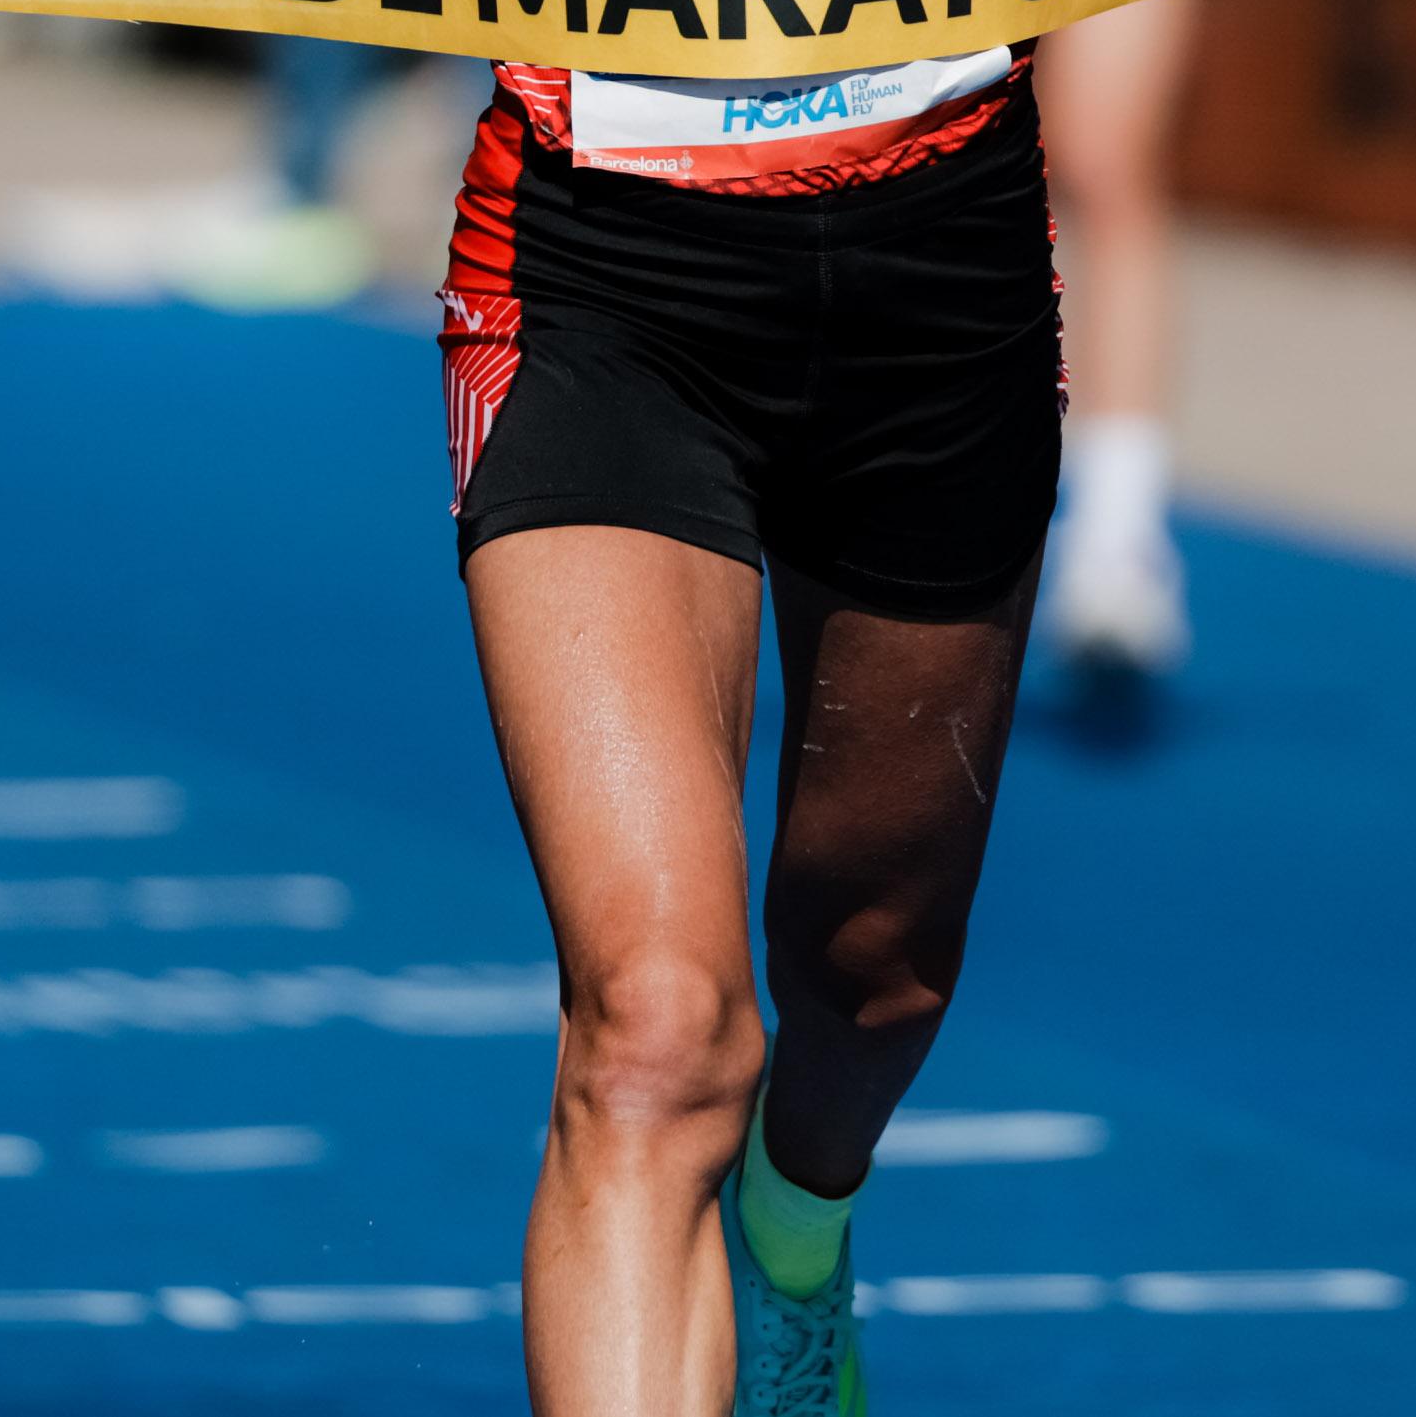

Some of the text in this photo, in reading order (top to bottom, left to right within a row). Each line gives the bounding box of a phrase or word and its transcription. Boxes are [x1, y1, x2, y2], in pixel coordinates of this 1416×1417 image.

[850, 77, 871, 92] FLY
[851, 83, 903, 104] HUMAN
[723, 82, 849, 133] HOKA
[853, 102, 874, 116] FLY
